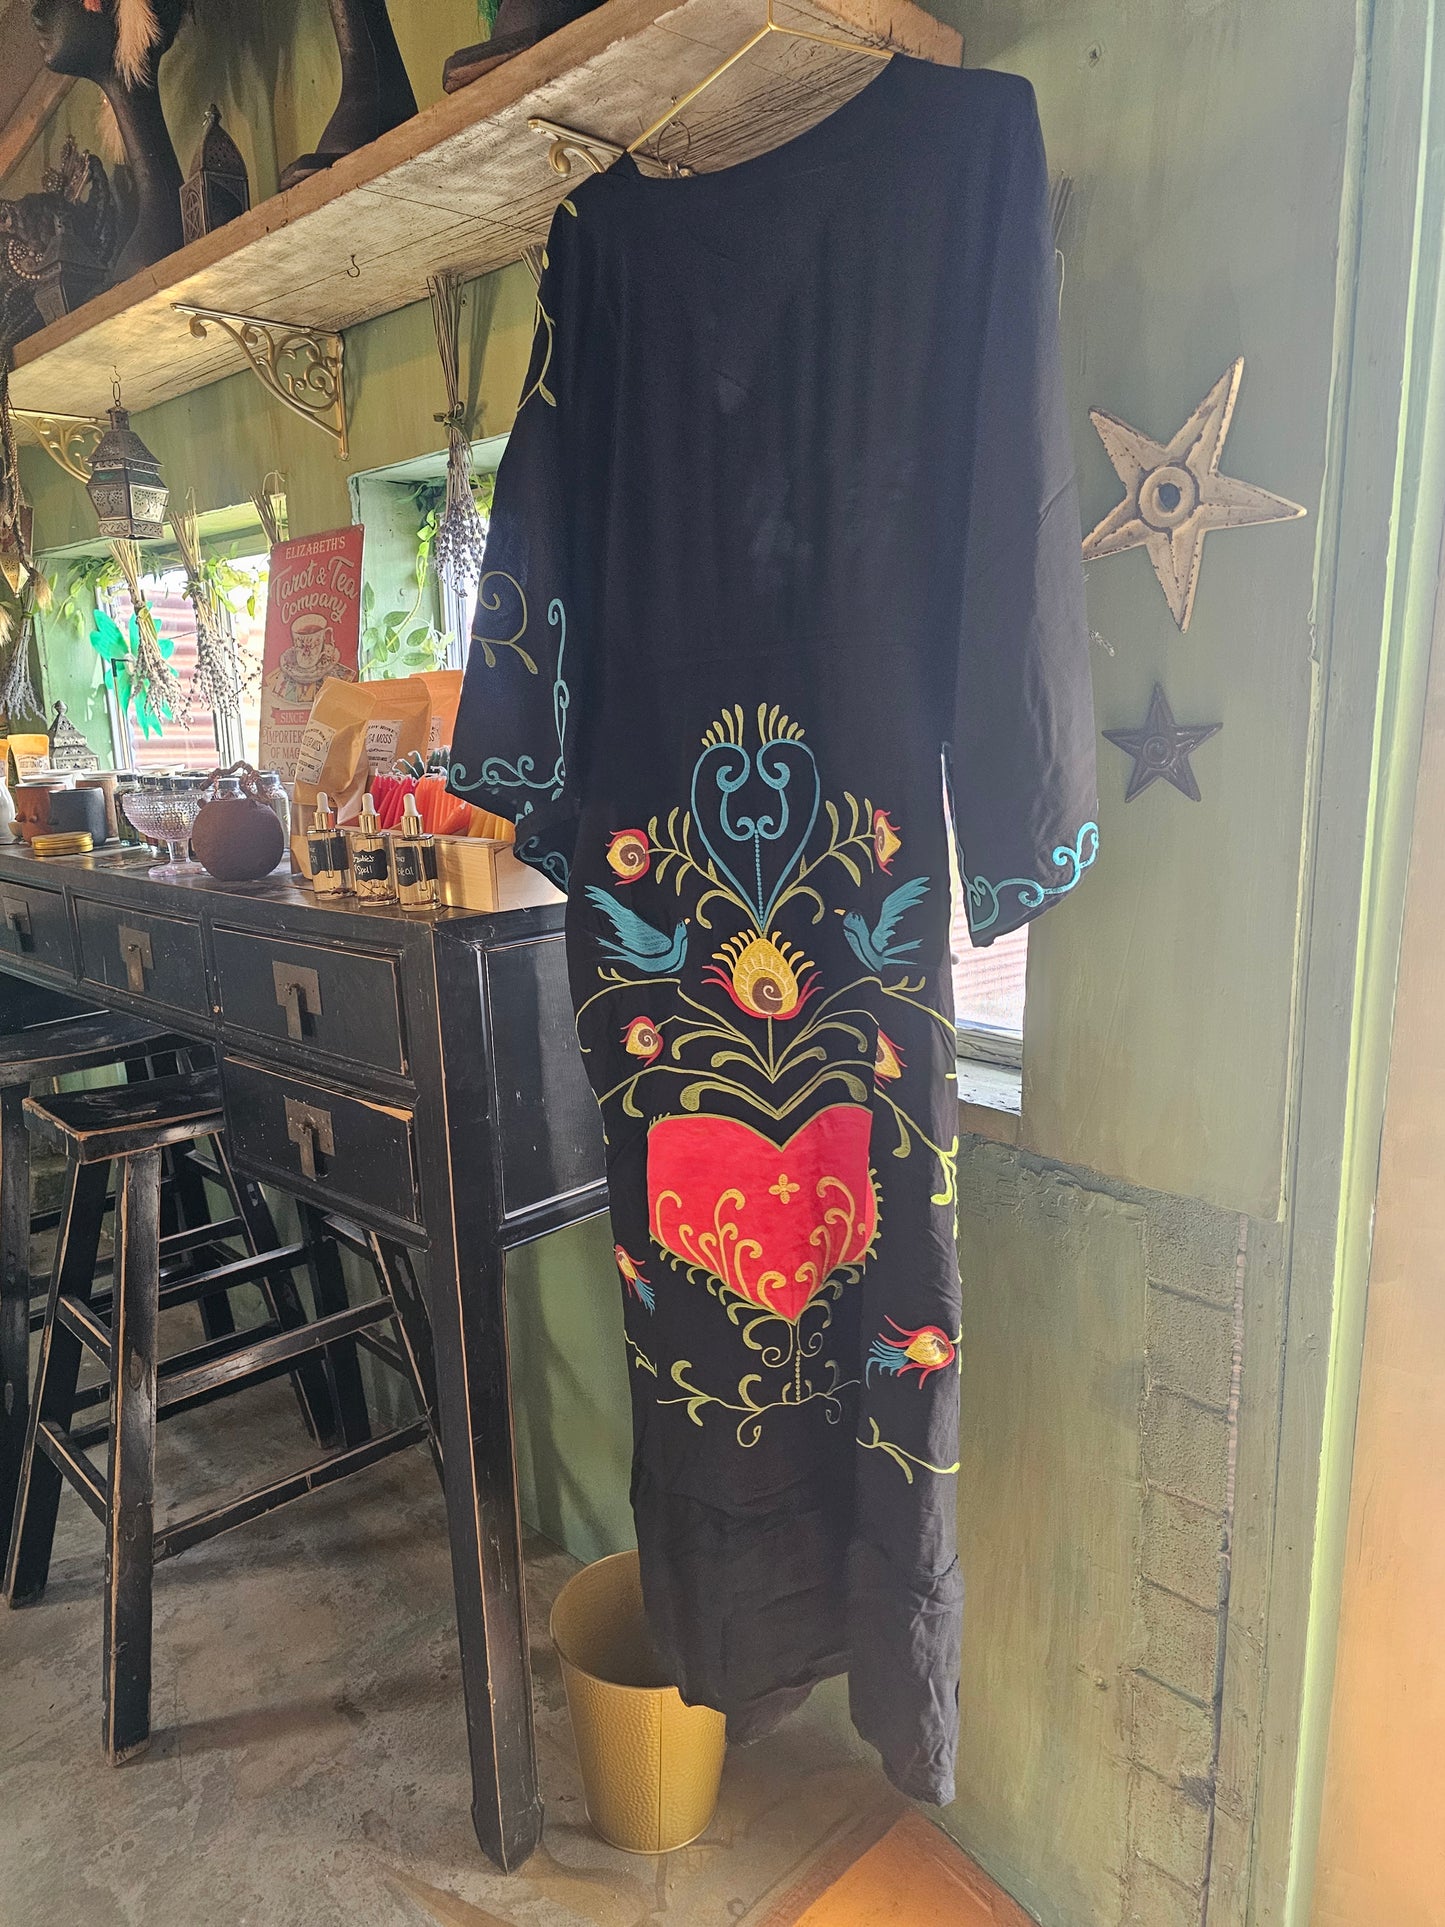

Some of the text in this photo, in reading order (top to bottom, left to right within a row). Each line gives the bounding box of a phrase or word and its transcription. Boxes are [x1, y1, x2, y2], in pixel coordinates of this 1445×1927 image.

[285, 536, 346, 560] ELIZABETH'S
[270, 556, 358, 607] Tarot & Tea
[281, 592, 347, 624] Company
[271, 747, 281, 759] OF
